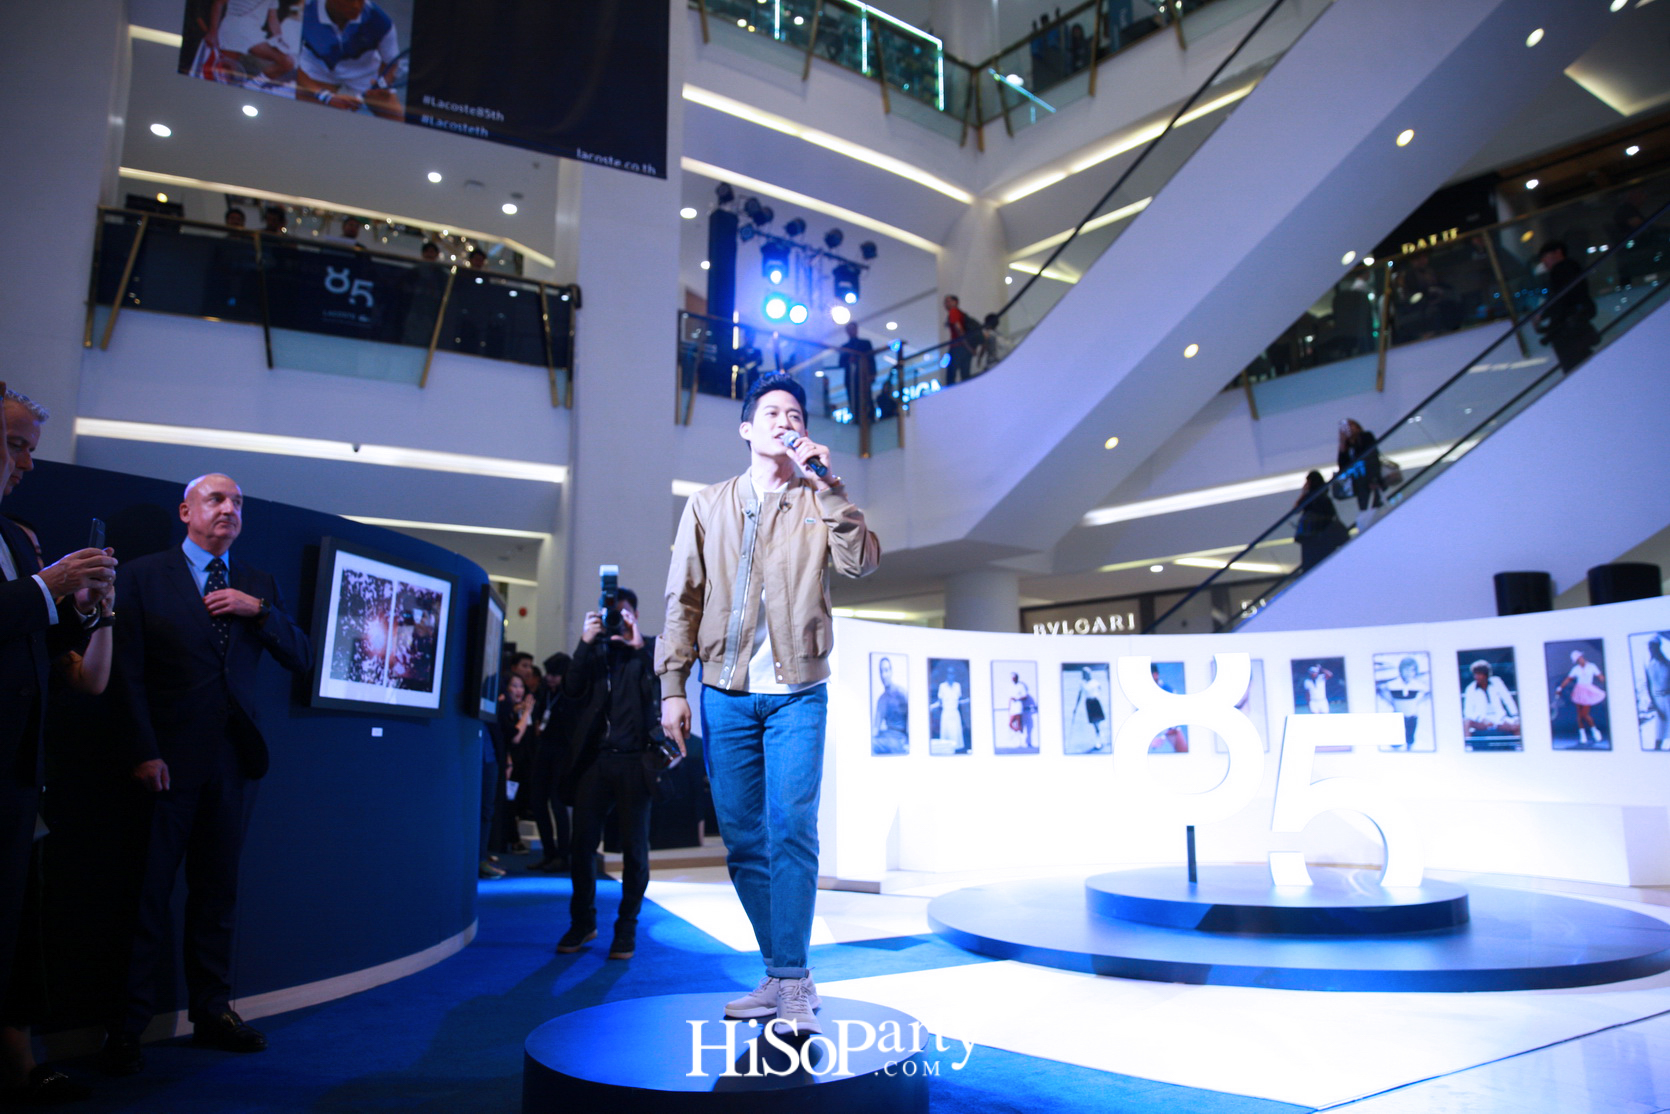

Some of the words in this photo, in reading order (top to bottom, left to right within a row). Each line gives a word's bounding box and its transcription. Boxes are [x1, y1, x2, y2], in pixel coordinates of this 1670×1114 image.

[422, 95, 504, 122] #Lacoste85th
[421, 114, 489, 138] #Lacosteth
[324, 266, 374, 307] 85
[1033, 613, 1135, 636] BVLGARI
[1113, 653, 1425, 887] 85
